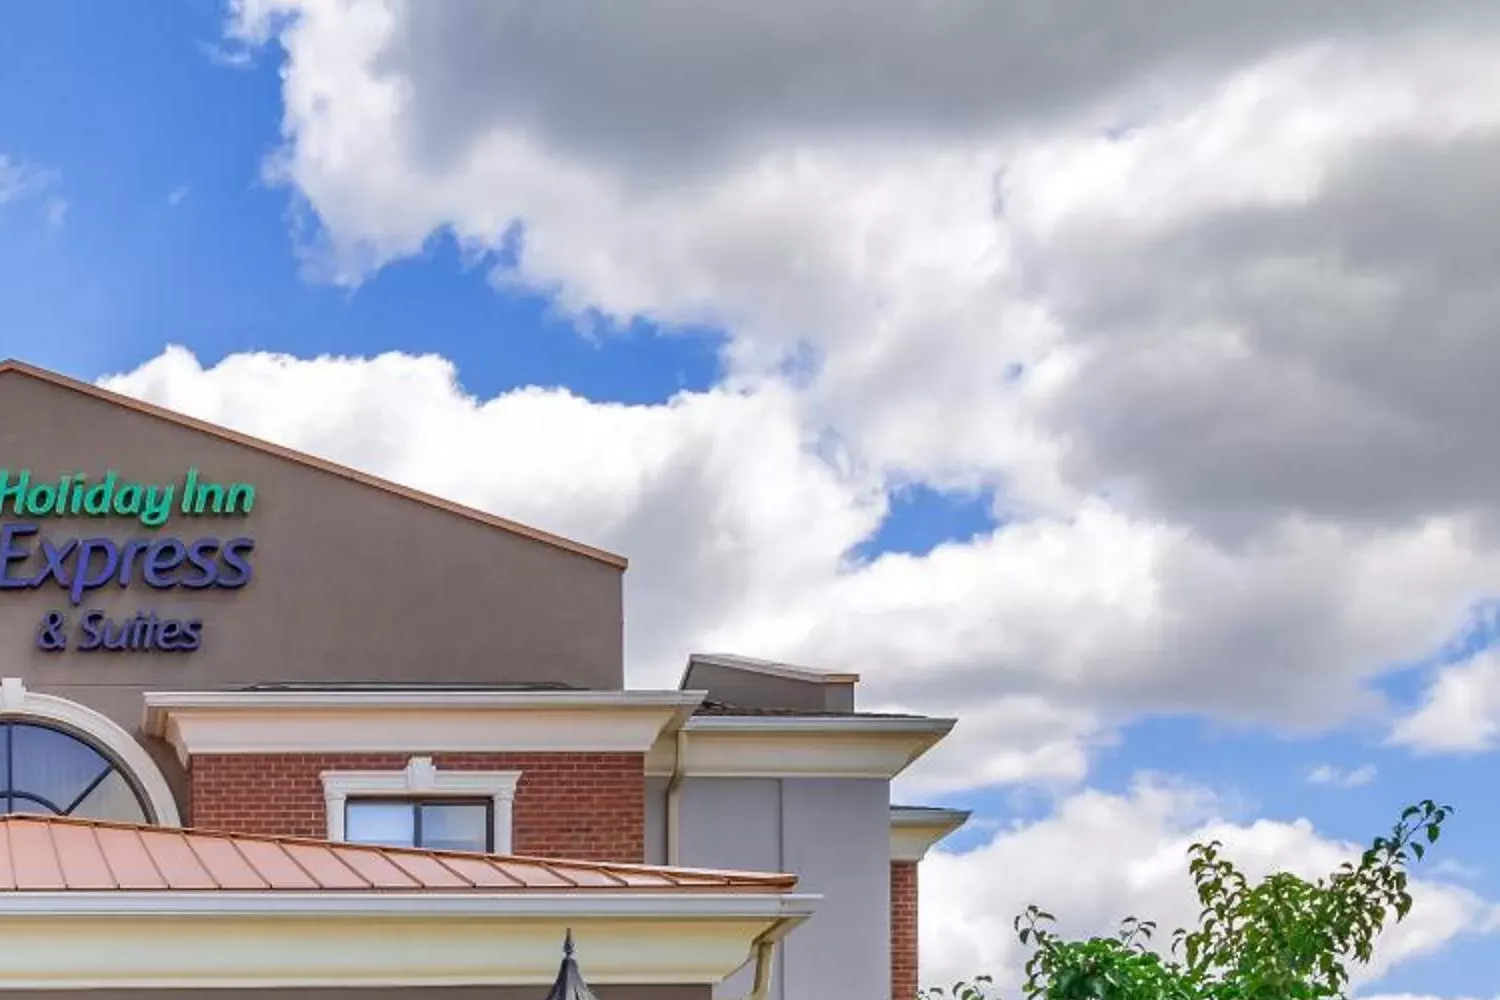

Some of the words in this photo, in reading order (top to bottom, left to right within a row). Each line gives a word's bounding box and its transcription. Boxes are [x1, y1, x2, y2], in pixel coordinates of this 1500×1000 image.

[181, 466, 255, 514] Inn
[36, 610, 67, 651] &
[78, 608, 203, 652] Suites
